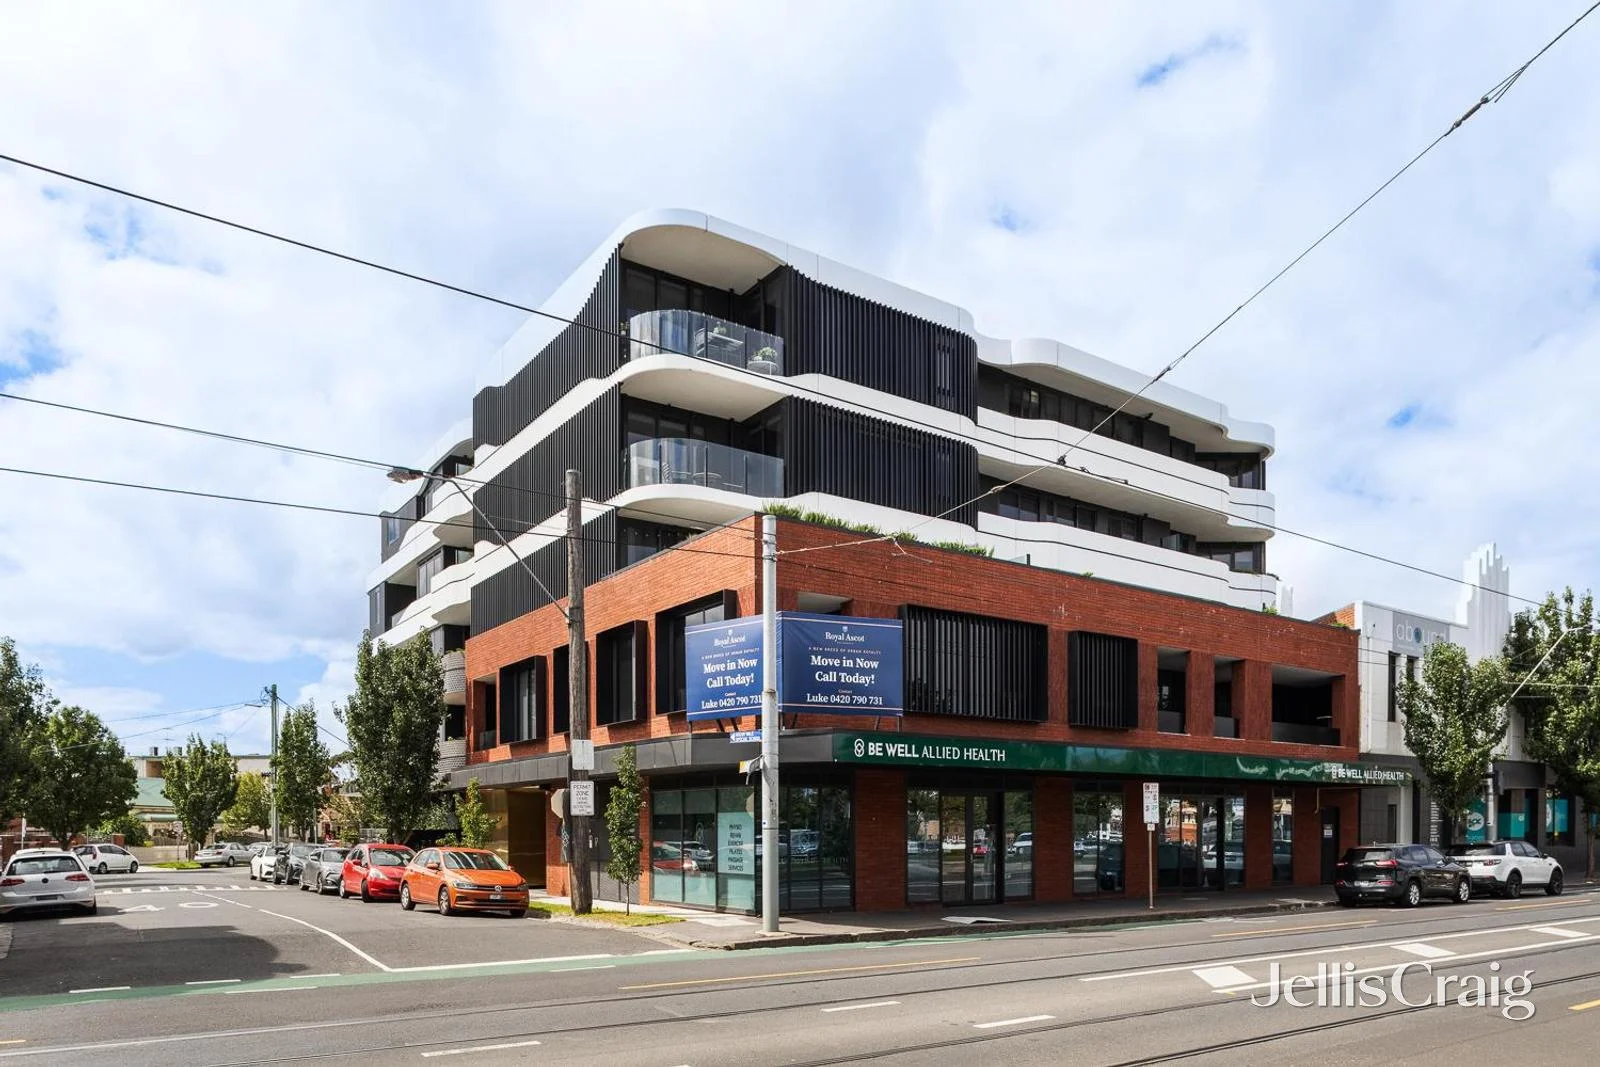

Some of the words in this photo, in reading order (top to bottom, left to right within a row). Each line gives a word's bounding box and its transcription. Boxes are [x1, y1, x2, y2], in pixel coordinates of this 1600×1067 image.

[825, 631, 845, 642] Royal
[845, 633, 865, 642] Ascot
[703, 662, 726, 674] Move
[727, 659, 736, 671] in
[737, 658, 758, 669] Now
[810, 655, 841, 667] Move
[842, 656, 854, 668] in
[855, 657, 880, 669] Now
[706, 675, 724, 689] Call
[724, 672, 755, 687] Today!
[815, 671, 837, 682] Call
[839, 672, 875, 687] Today!
[701, 699, 718, 709] Luke
[718, 697, 736, 707] 0420
[736, 696, 749, 706] 790
[749, 694, 761, 704] 731
[806, 693, 829, 703] Luke
[830, 694, 851, 704] 0420
[852, 695, 867, 705] 790
[869, 696, 884, 705] 731
[868, 742, 884, 756] BE
[885, 743, 919, 758] WELL
[921, 745, 961, 760] ALLIED
[963, 748, 1006, 762] HEALTH
[1338, 768, 1346, 778] BE
[1346, 769, 1362, 779] WELL
[1363, 770, 1383, 780] ALLIED
[1382, 771, 1405, 781] HEALTH
